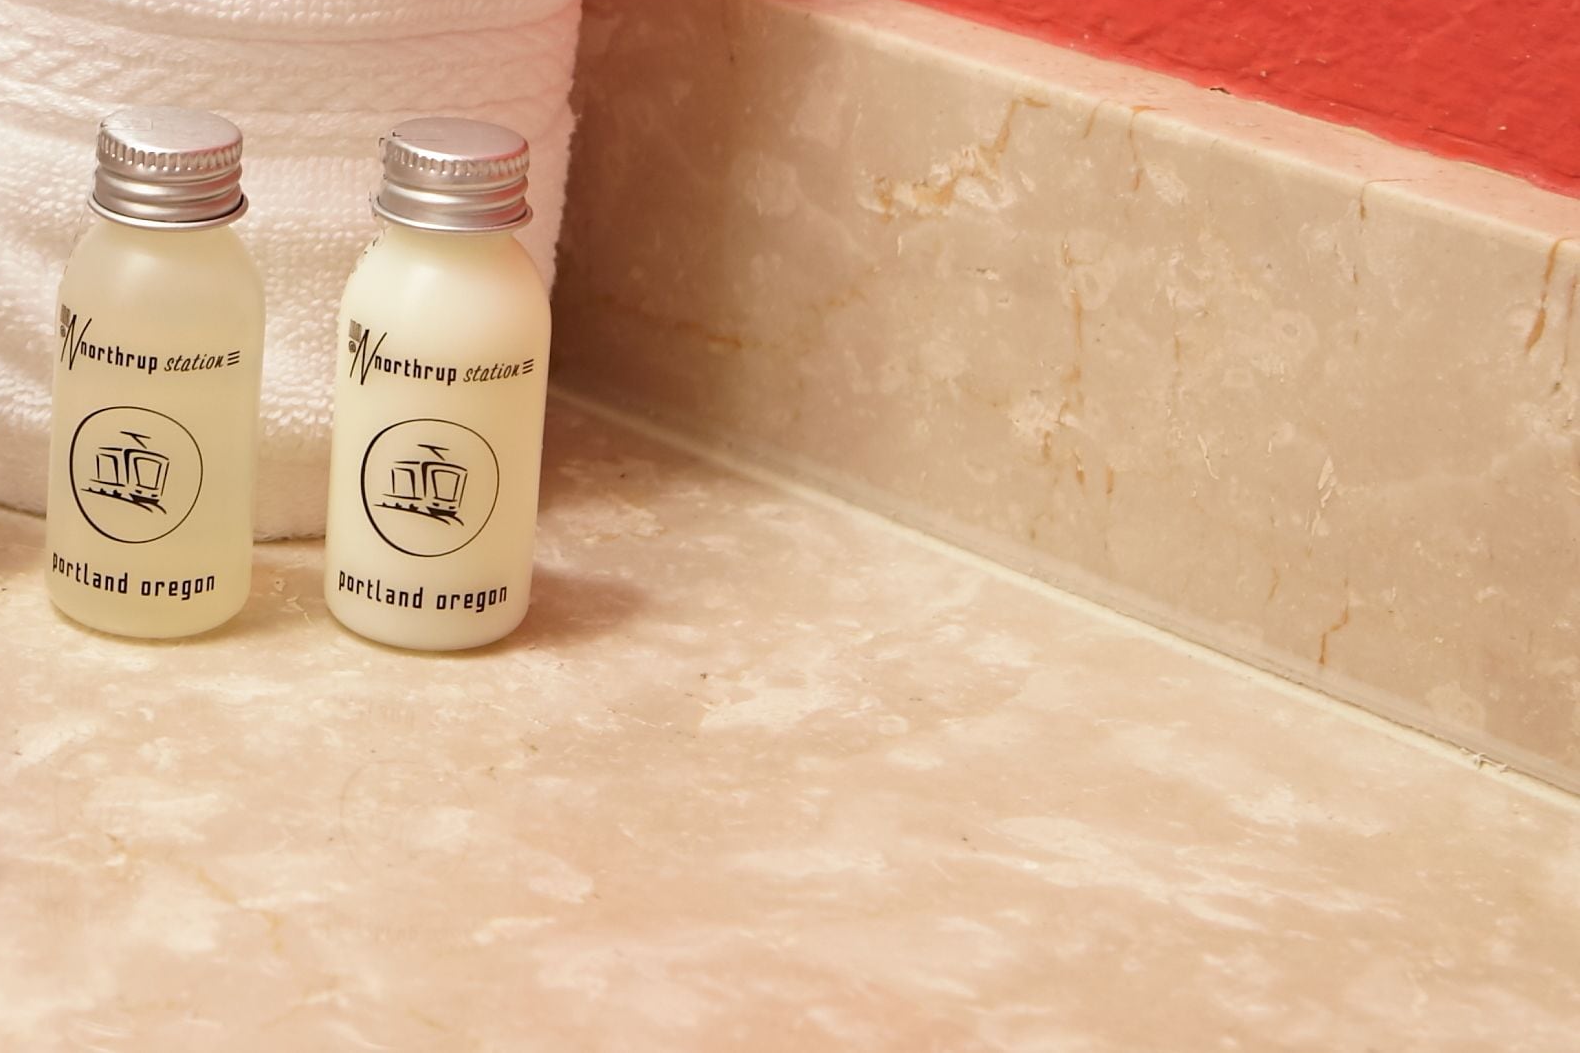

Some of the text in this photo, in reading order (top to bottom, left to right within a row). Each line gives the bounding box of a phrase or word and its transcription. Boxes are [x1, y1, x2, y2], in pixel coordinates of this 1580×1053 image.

[164, 352, 226, 372] station
[463, 363, 521, 383] station
[52, 552, 215, 600] portland oregon
[339, 570, 507, 612] portland oregon
